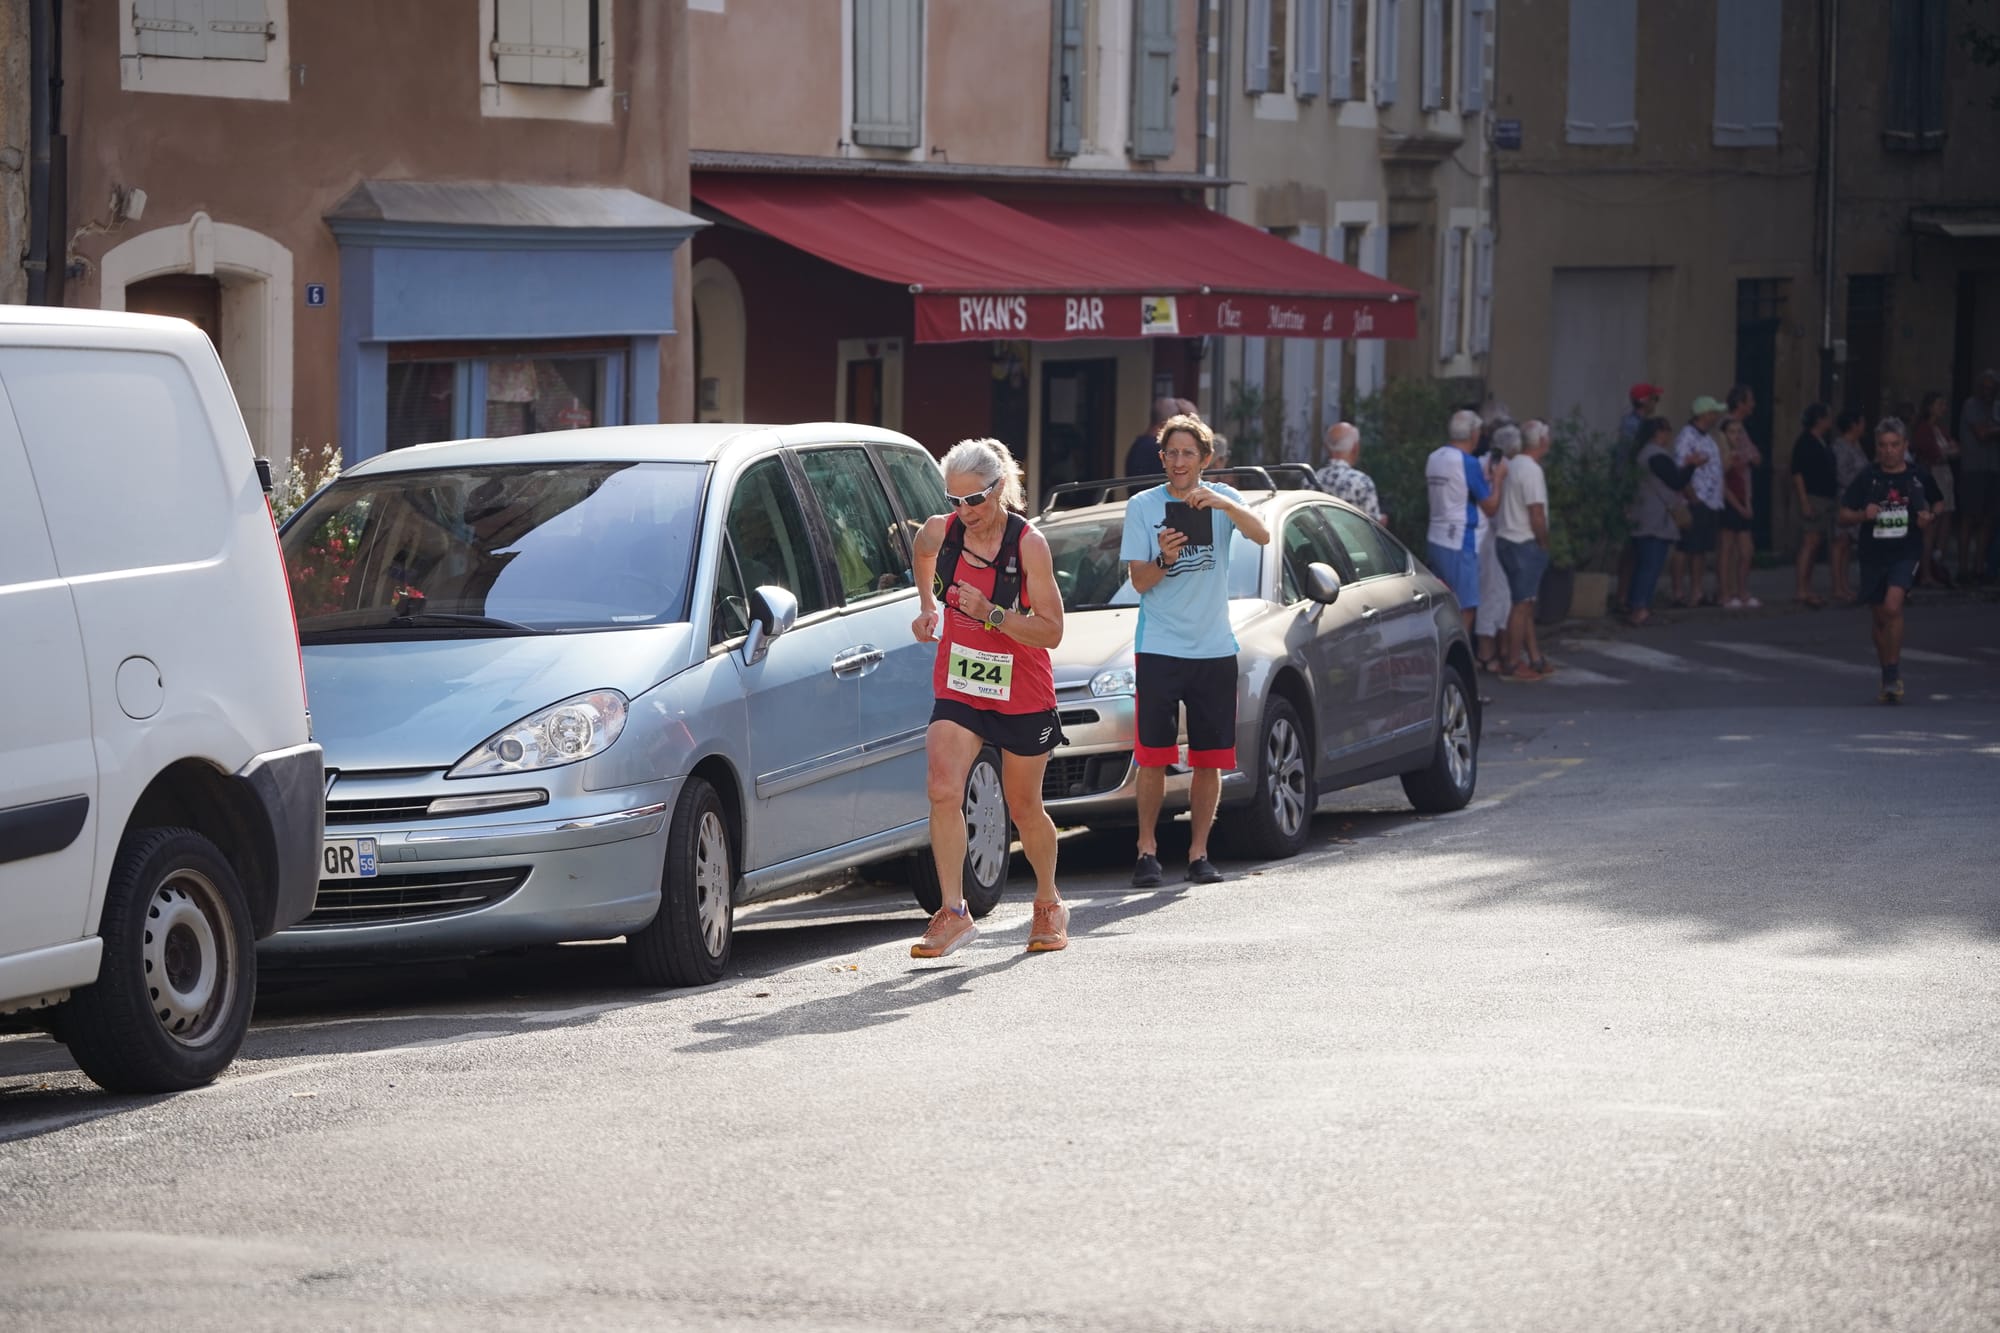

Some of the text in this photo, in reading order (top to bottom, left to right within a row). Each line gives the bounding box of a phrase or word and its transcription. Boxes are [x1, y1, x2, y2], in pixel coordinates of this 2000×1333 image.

[312, 287, 320, 303] 6
[960, 297, 1027, 332] RYAN'S
[1065, 298, 1104, 331] BAR
[1217, 299, 1373, 336] Chez Martine et John
[958, 659, 1002, 684] 124
[361, 858, 374, 870] 59
